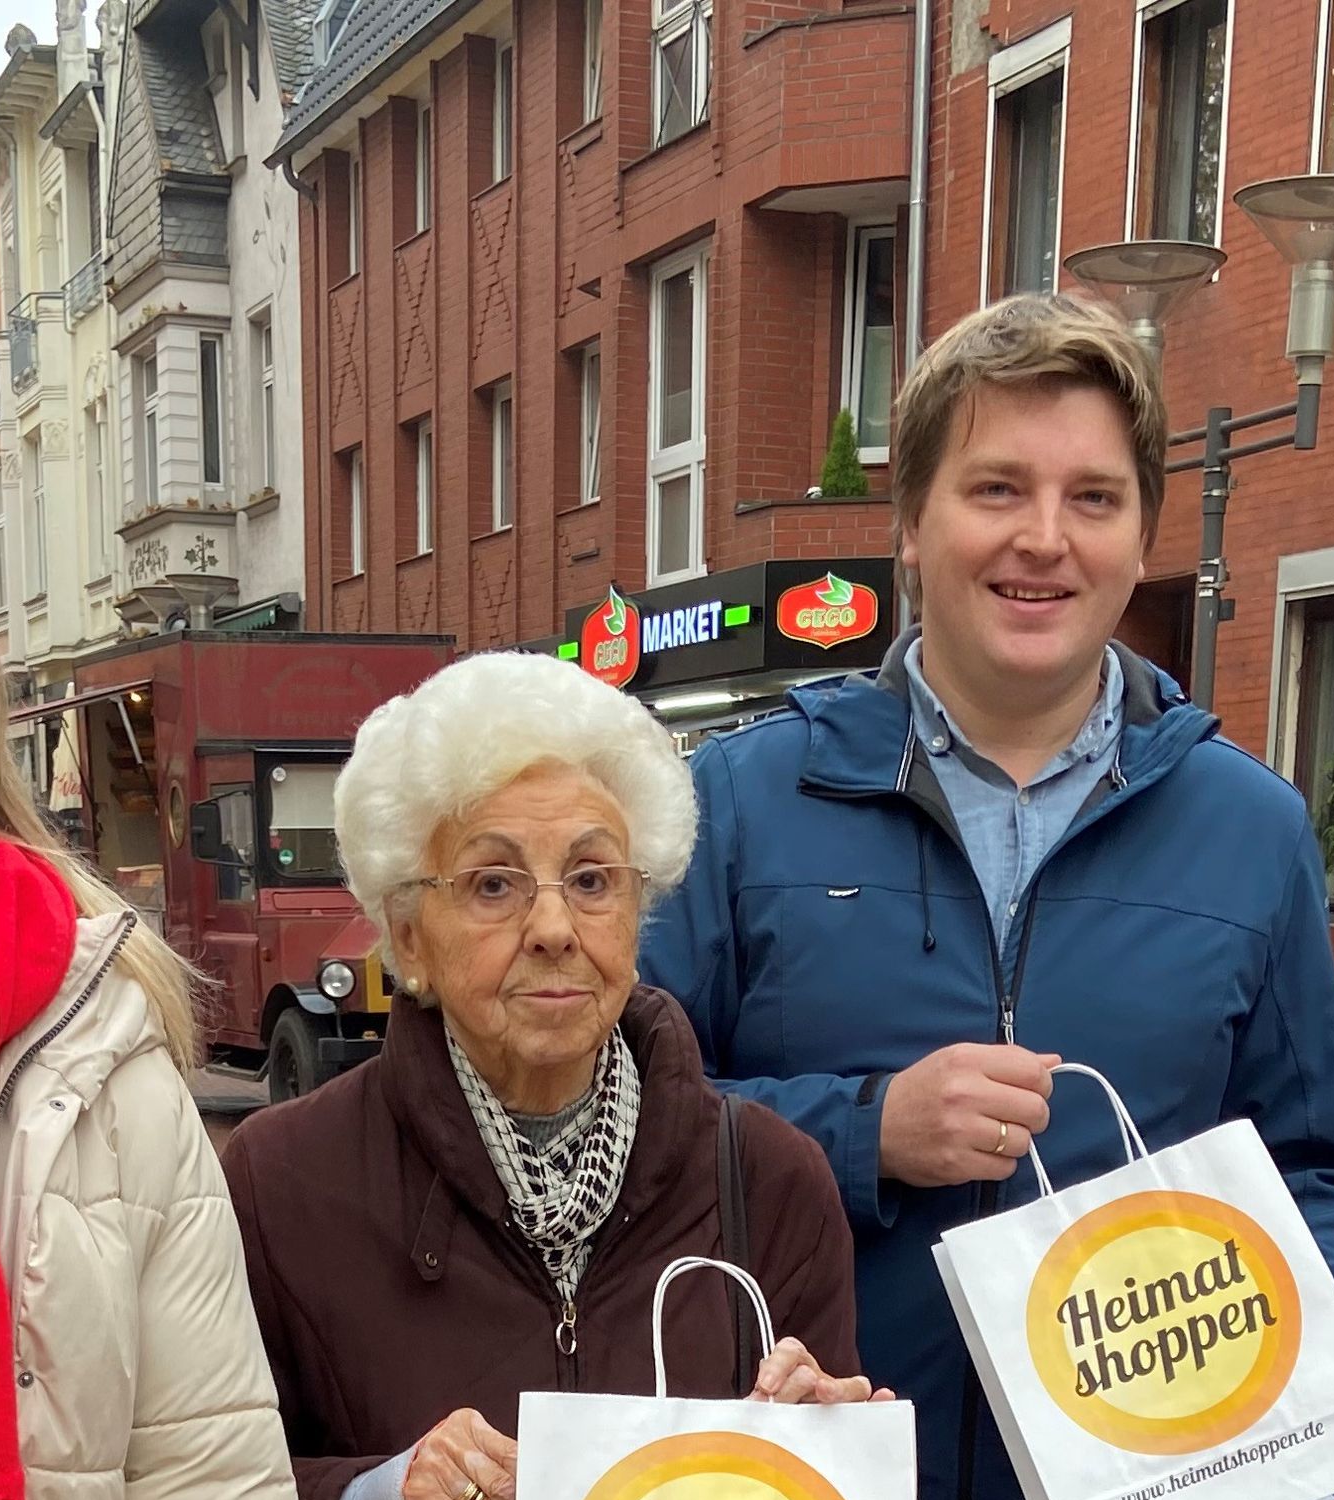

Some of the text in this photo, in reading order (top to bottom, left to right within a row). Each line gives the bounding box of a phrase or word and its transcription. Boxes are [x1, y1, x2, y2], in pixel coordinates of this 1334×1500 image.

[642, 600, 723, 654] MARKET
[1057, 1237, 1246, 1347] Heimat
[1074, 1292, 1277, 1398] shoppen
